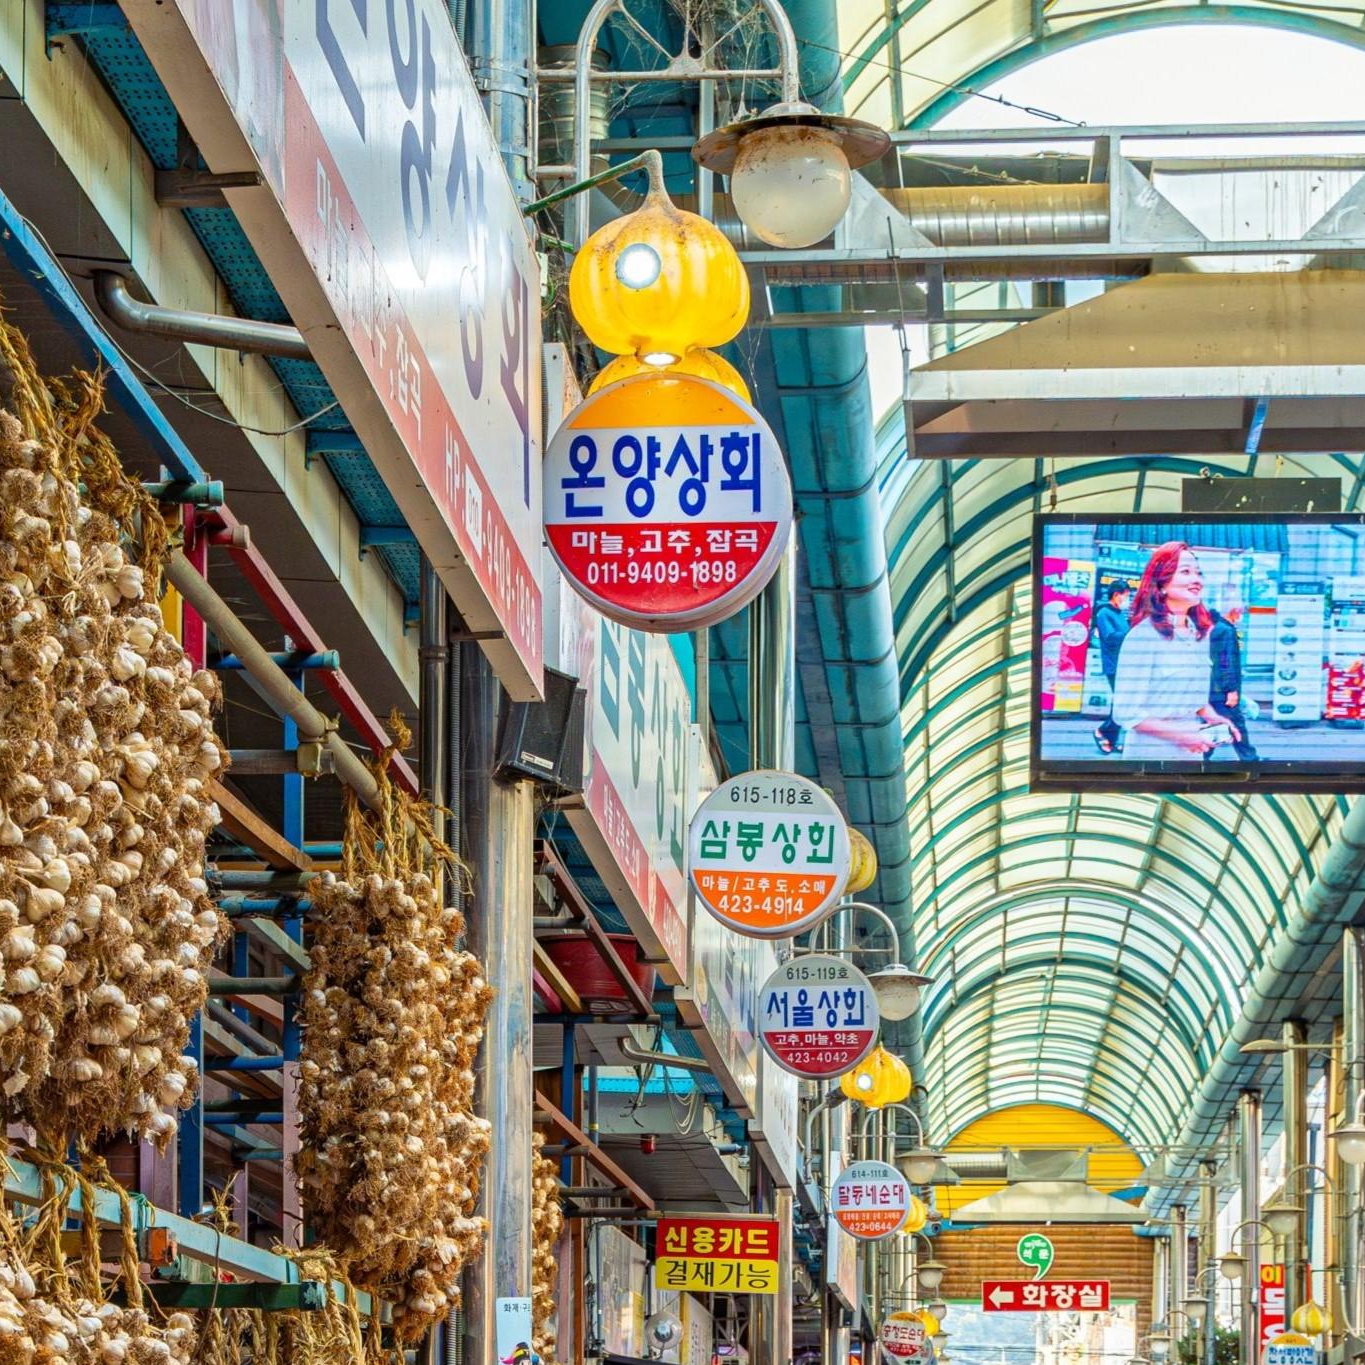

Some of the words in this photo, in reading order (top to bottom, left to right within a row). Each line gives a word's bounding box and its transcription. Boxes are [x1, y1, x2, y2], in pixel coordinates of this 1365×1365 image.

[561, 431, 761, 518] 온양상회
[587, 560, 737, 585] 011-9409-1898
[730, 786, 813, 805] 615-118호
[700, 819, 835, 865] 삼봉상회
[718, 894, 805, 914] 423-4914
[766, 987, 864, 1028] 서울상회
[787, 1051, 849, 1064] 423-4042
[664, 1226, 770, 1255] 신용카드
[665, 1260, 771, 1289] 결재가능
[1022, 1284, 1103, 1308] 화장실
